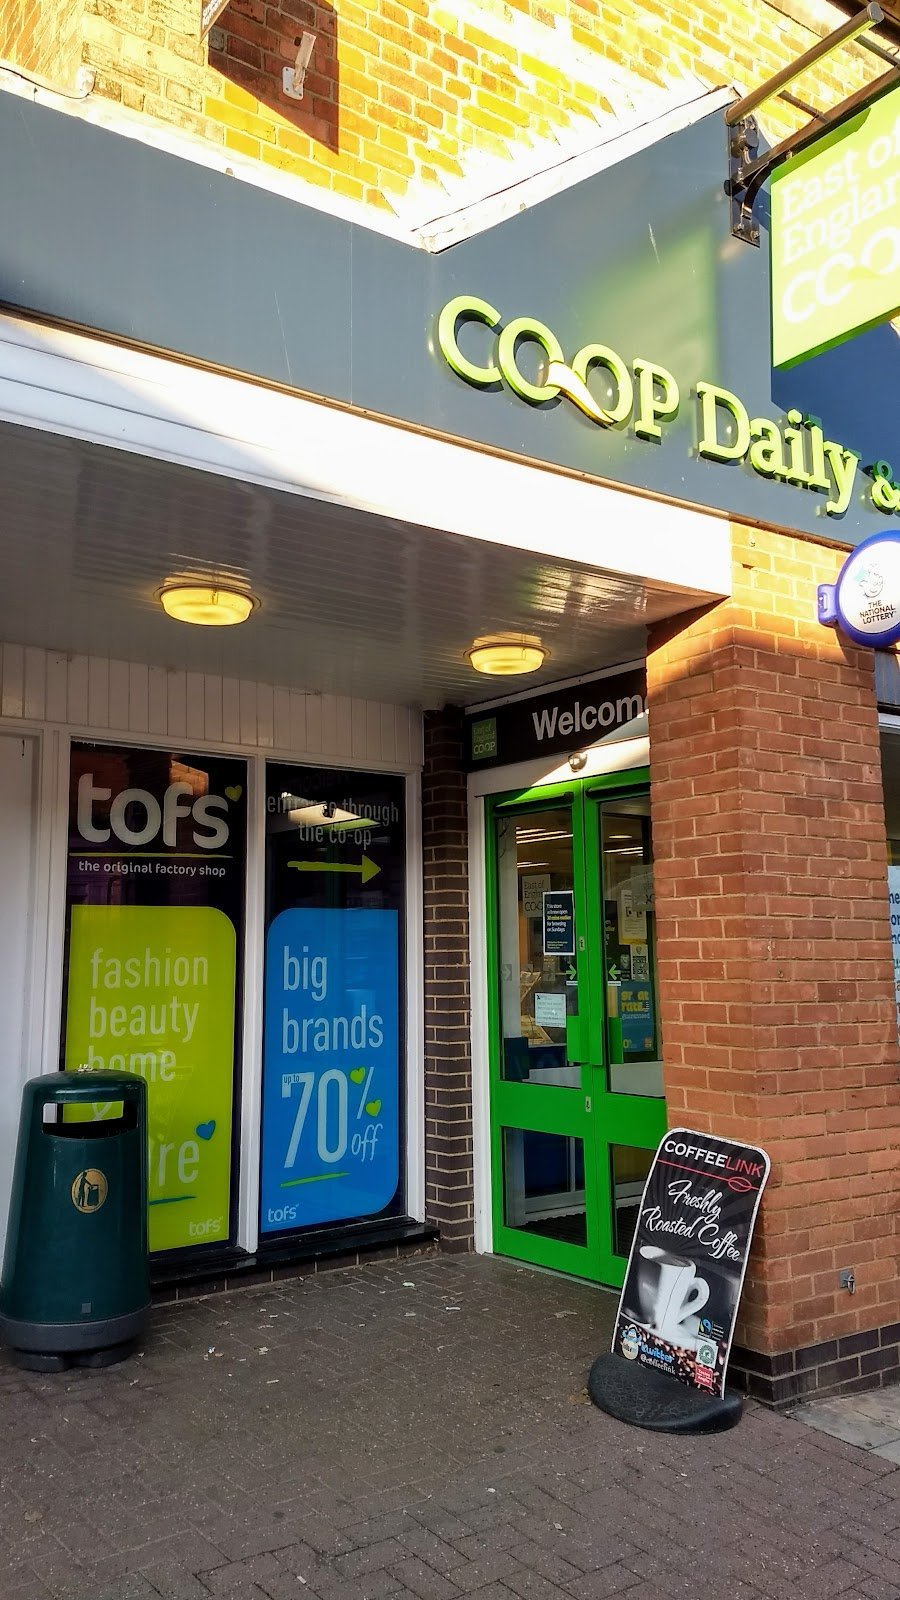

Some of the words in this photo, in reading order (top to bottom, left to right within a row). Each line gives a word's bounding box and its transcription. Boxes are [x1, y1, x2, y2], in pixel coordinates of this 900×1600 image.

[781, 149, 859, 223] East
[782, 171, 900, 266] Englan
[781, 227, 900, 324] COO
[697, 381, 861, 514] Daily
[860, 605, 896, 618] NATIONAL
[863, 611, 894, 624] LOTTERY
[868, 600, 882, 608] THE
[532, 694, 648, 740] Welcom
[77, 773, 229, 849] tofs
[342, 798, 399, 826] through
[299, 822, 324, 842] the
[329, 824, 371, 850] co-op
[78, 860, 100, 872] the
[103, 861, 153, 875] original
[155, 863, 197, 877] factory
[199, 865, 226, 878] shop
[90, 948, 208, 989] fashion
[283, 946, 327, 1001] big
[89, 995, 200, 1042] beauty
[282, 1005, 384, 1054] brands
[283, 1074, 292, 1085] up
[293, 1074, 300, 1083] to
[351, 1123, 383, 1162] off
[268, 1205, 297, 1223] tofs
[668, 1180, 723, 1224] Freshly
[188, 1218, 221, 1237] tofs
[642, 1206, 706, 1238] Roasted
[698, 1223, 741, 1261] Coffee
[641, 1344, 674, 1363] twitter
